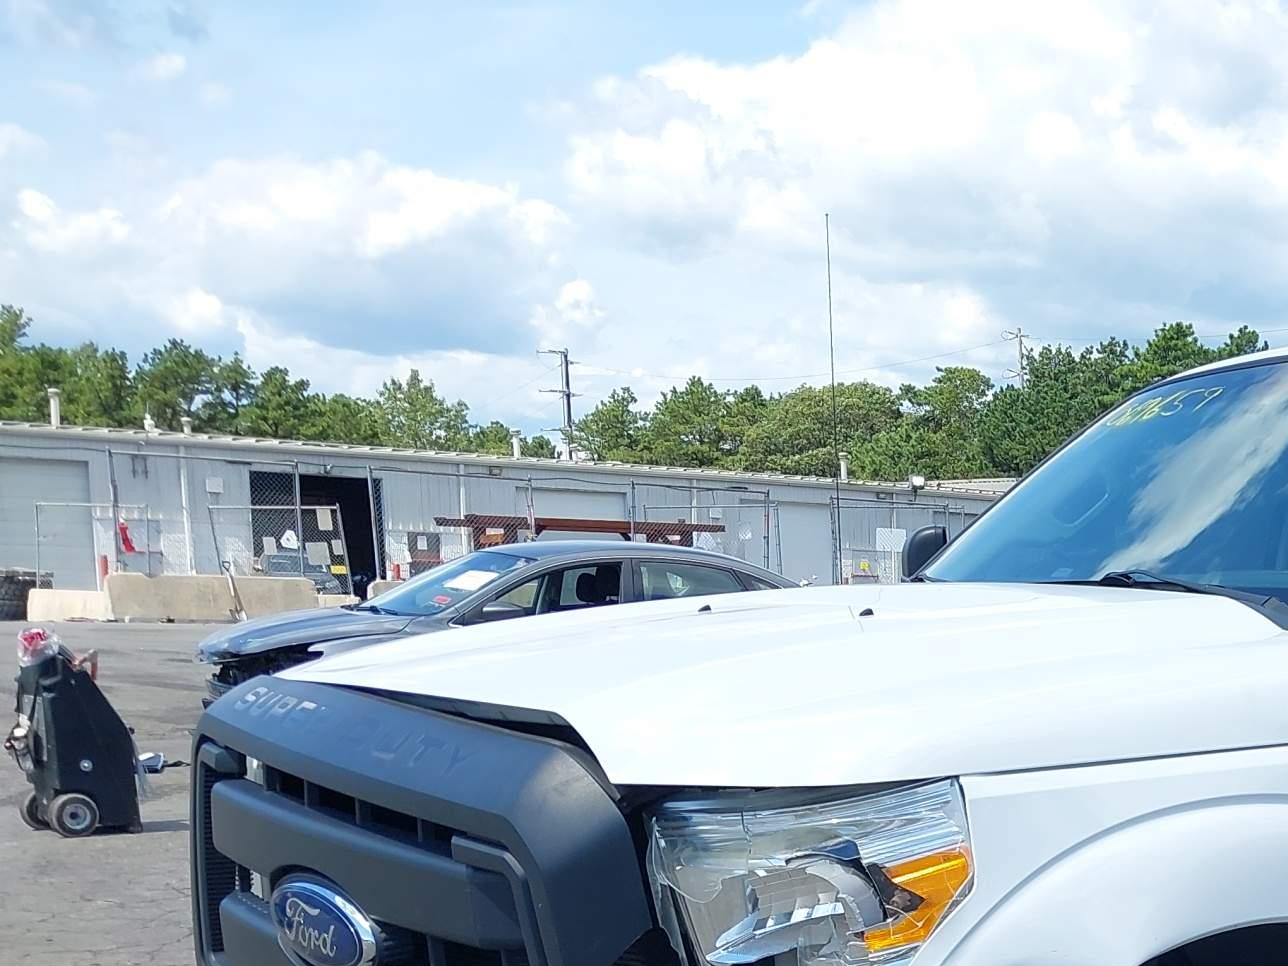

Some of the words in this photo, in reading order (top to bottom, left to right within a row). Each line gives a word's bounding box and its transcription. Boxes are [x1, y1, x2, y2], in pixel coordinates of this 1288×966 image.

[233, 686, 330, 732] SUPE
[350, 718, 479, 777] UTY
[283, 897, 337, 959] Ford
